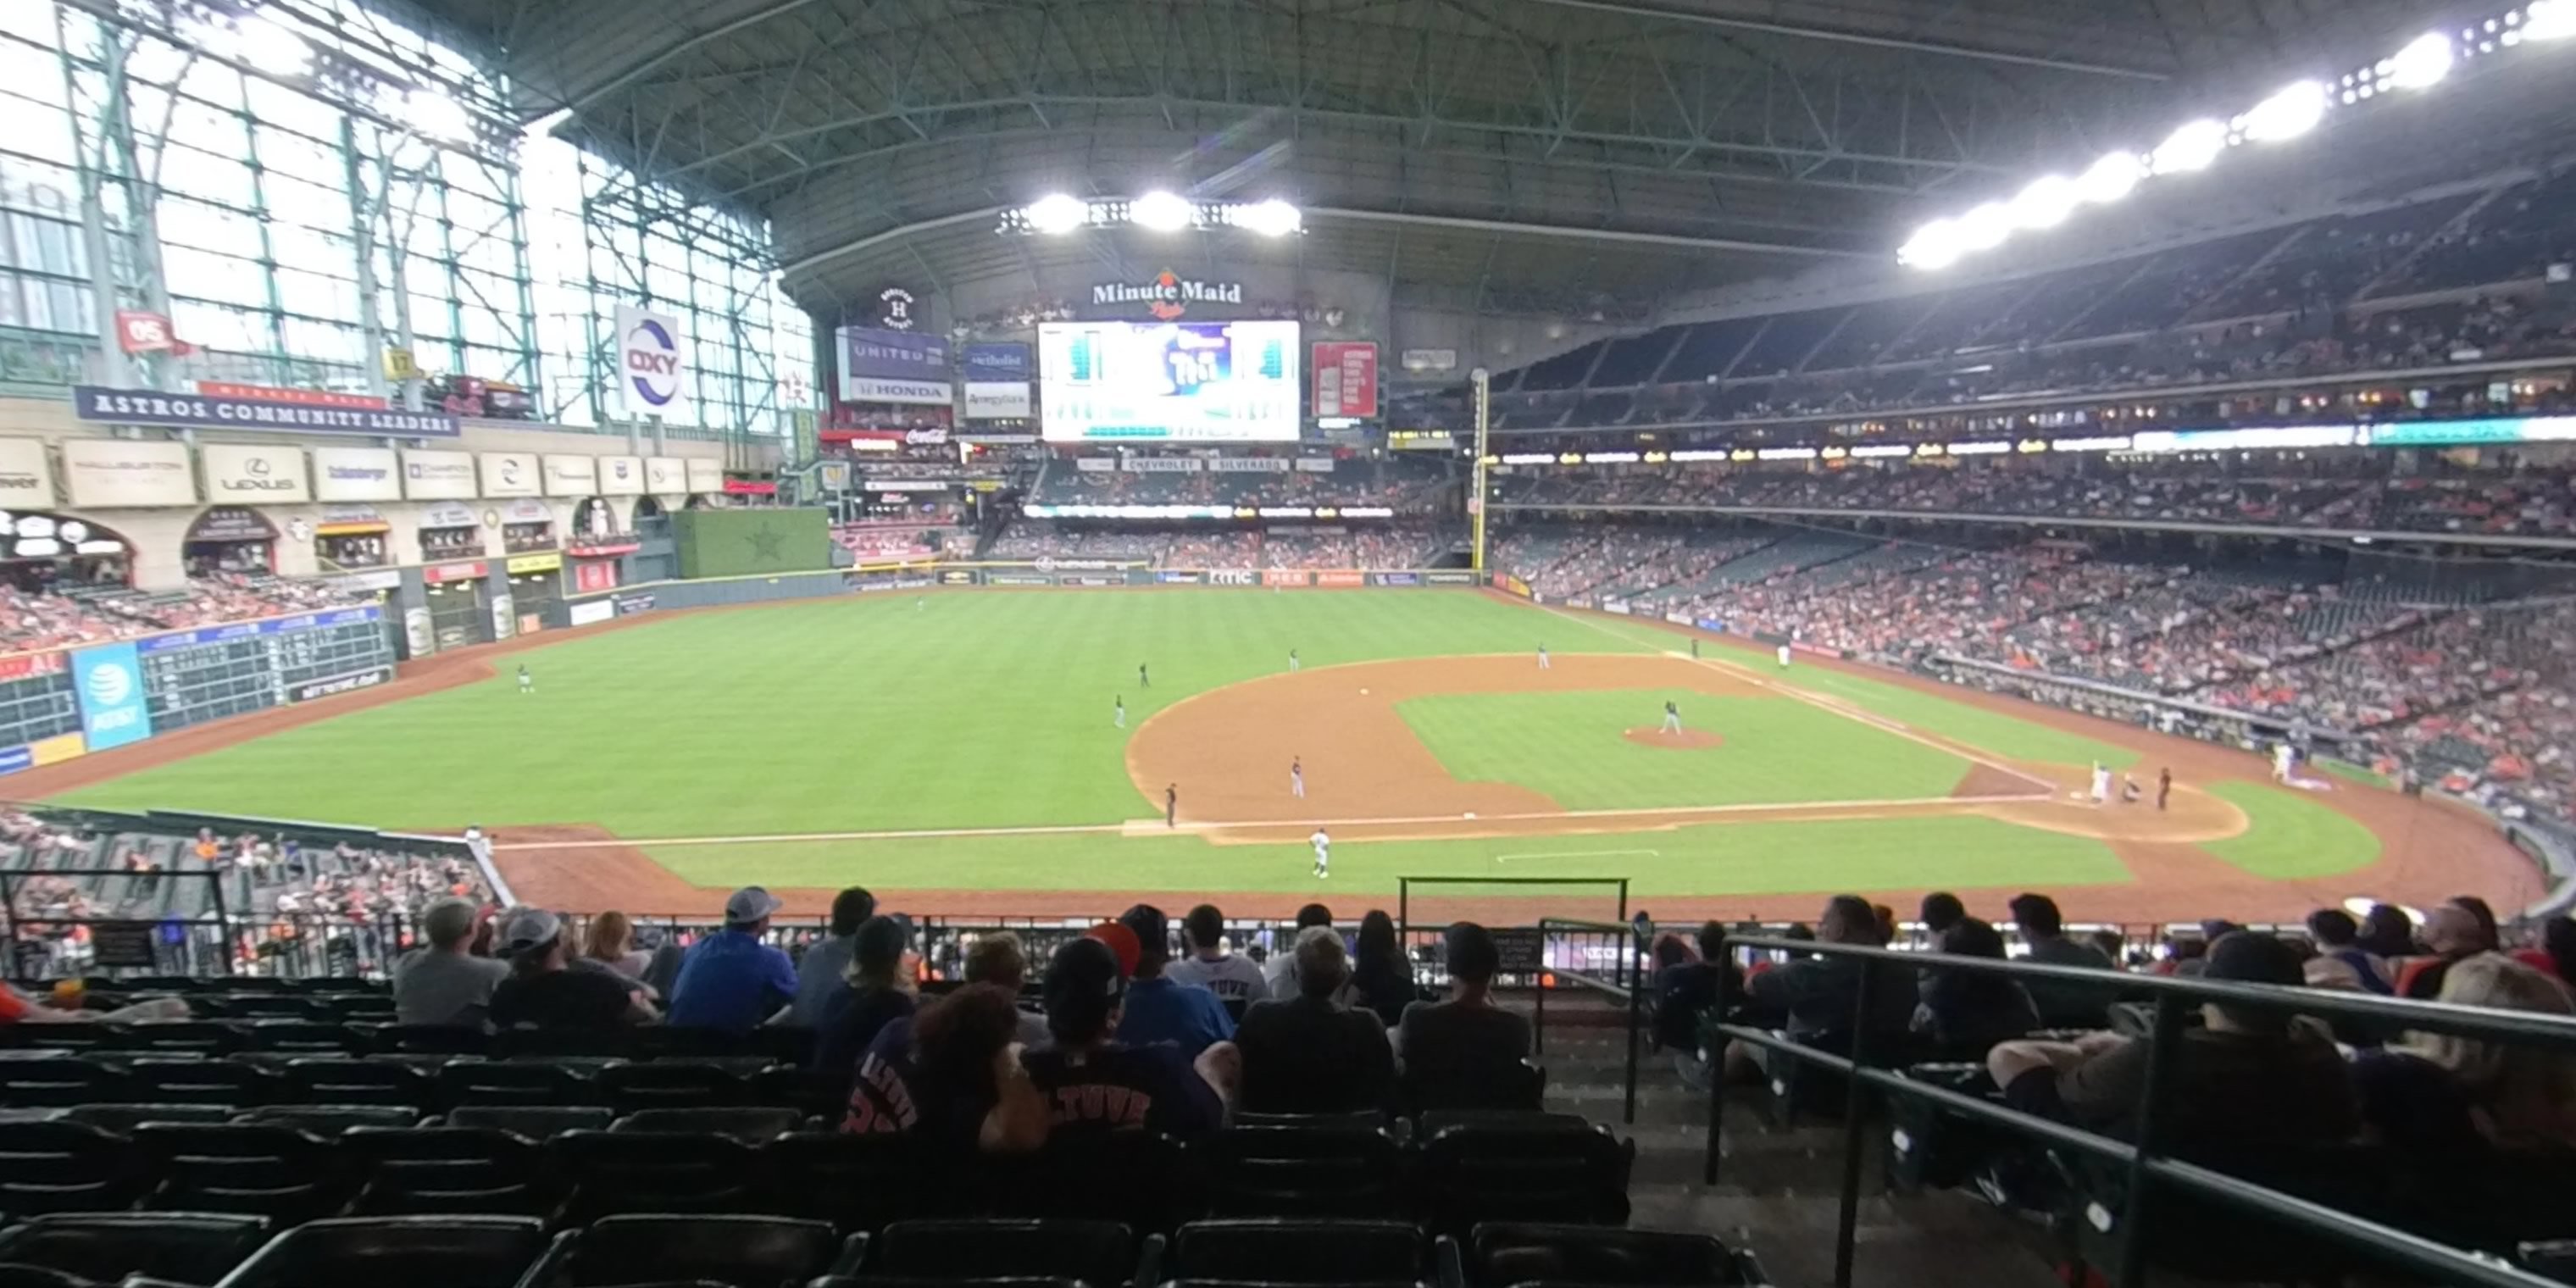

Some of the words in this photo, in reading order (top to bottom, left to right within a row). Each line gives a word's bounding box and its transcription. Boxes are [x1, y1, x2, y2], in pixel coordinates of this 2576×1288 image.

[1094, 283, 1177, 304] Minute
[1182, 281, 1241, 303] Maid
[891, 301, 907, 318] H
[628, 348, 678, 375] OXY
[854, 346, 924, 361] UNITED
[876, 386, 943, 398] HONDA
[94, 395, 207, 417] ASTROS
[216, 402, 364, 426] COMMUNITY
[369, 413, 452, 431] LEADERS
[1129, 460, 1193, 469] CHEVROLET
[1219, 460, 1280, 469] SILVERADO
[222, 479, 295, 491] LEXUS
